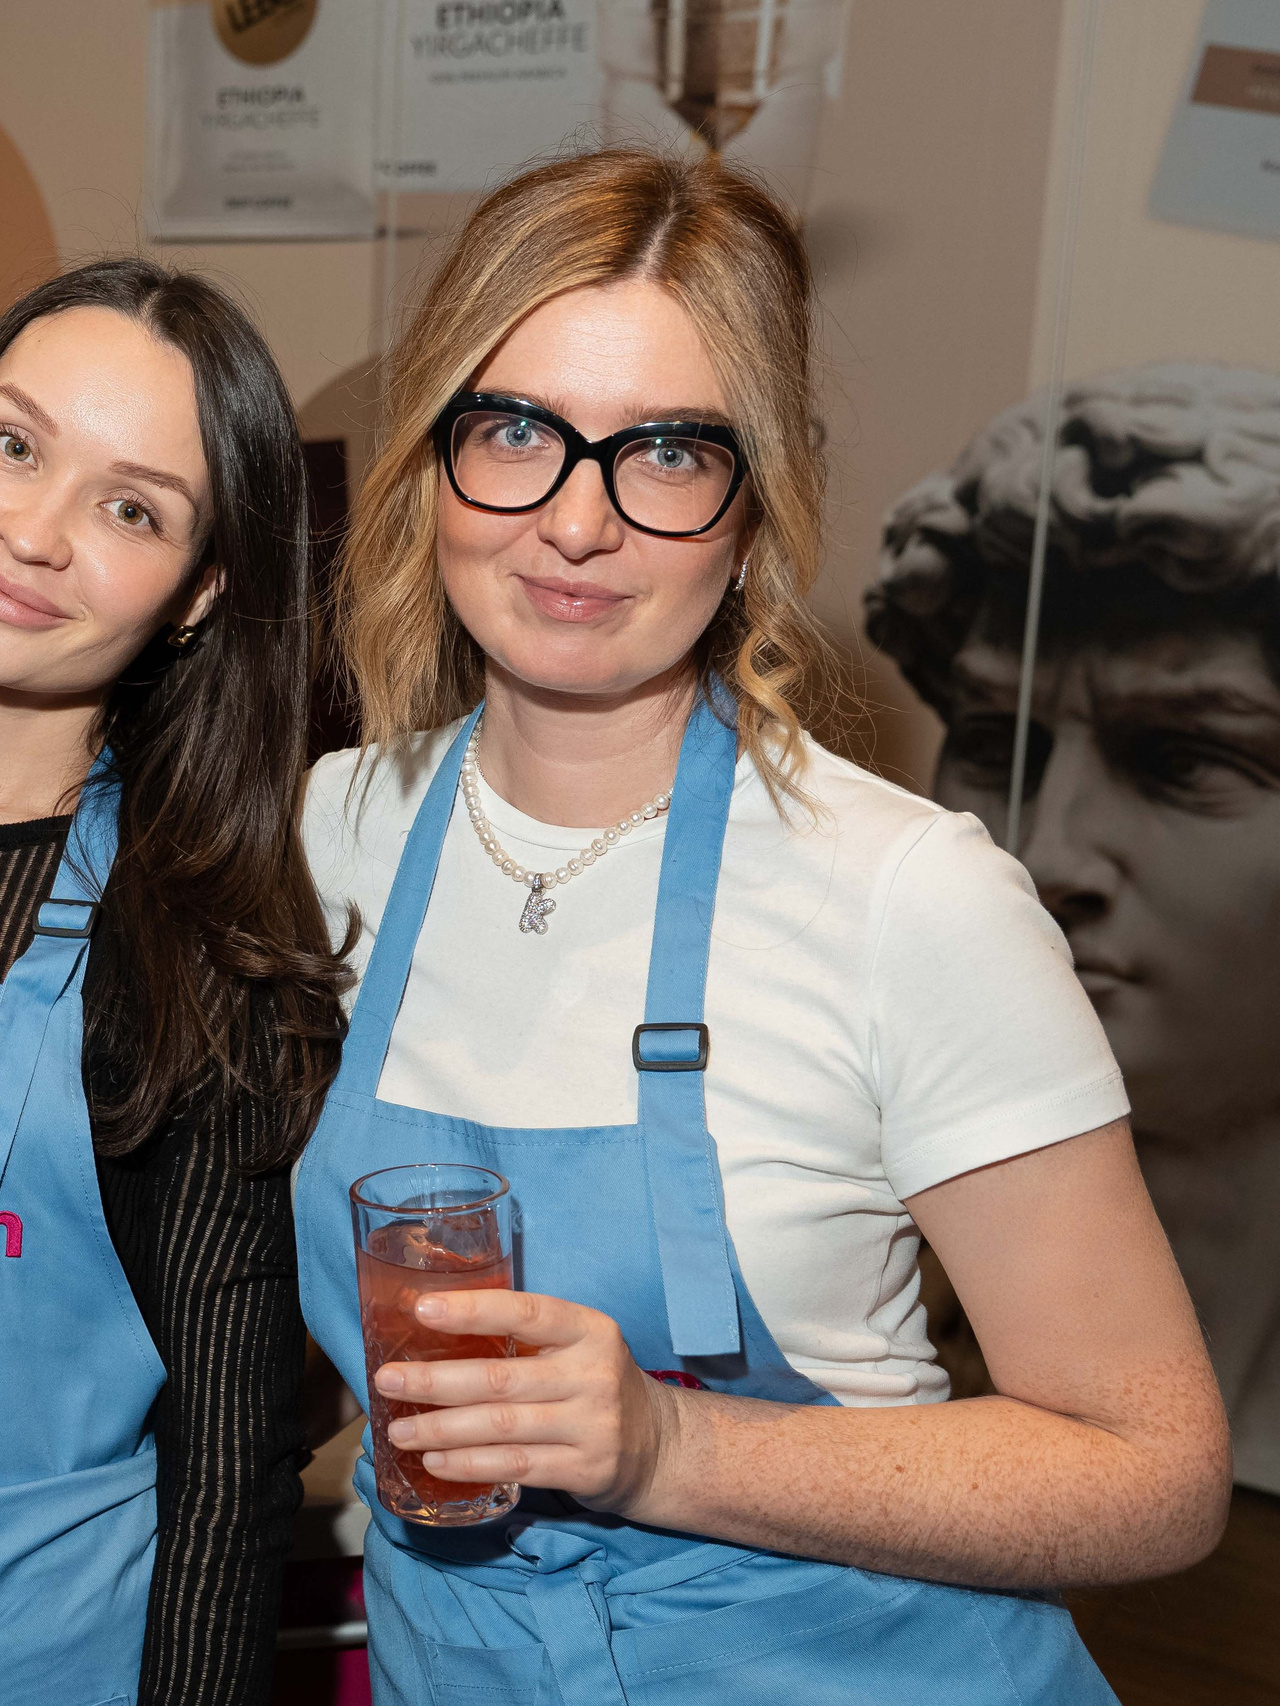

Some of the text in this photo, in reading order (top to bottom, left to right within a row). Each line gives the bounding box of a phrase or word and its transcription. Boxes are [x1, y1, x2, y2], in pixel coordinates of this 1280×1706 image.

[225, 0, 291, 34] LEB
[435, 0, 566, 29] ETHIOPIA
[409, 21, 589, 59] YIRGACHEFFE
[217, 85, 306, 108] ETHIOPIA
